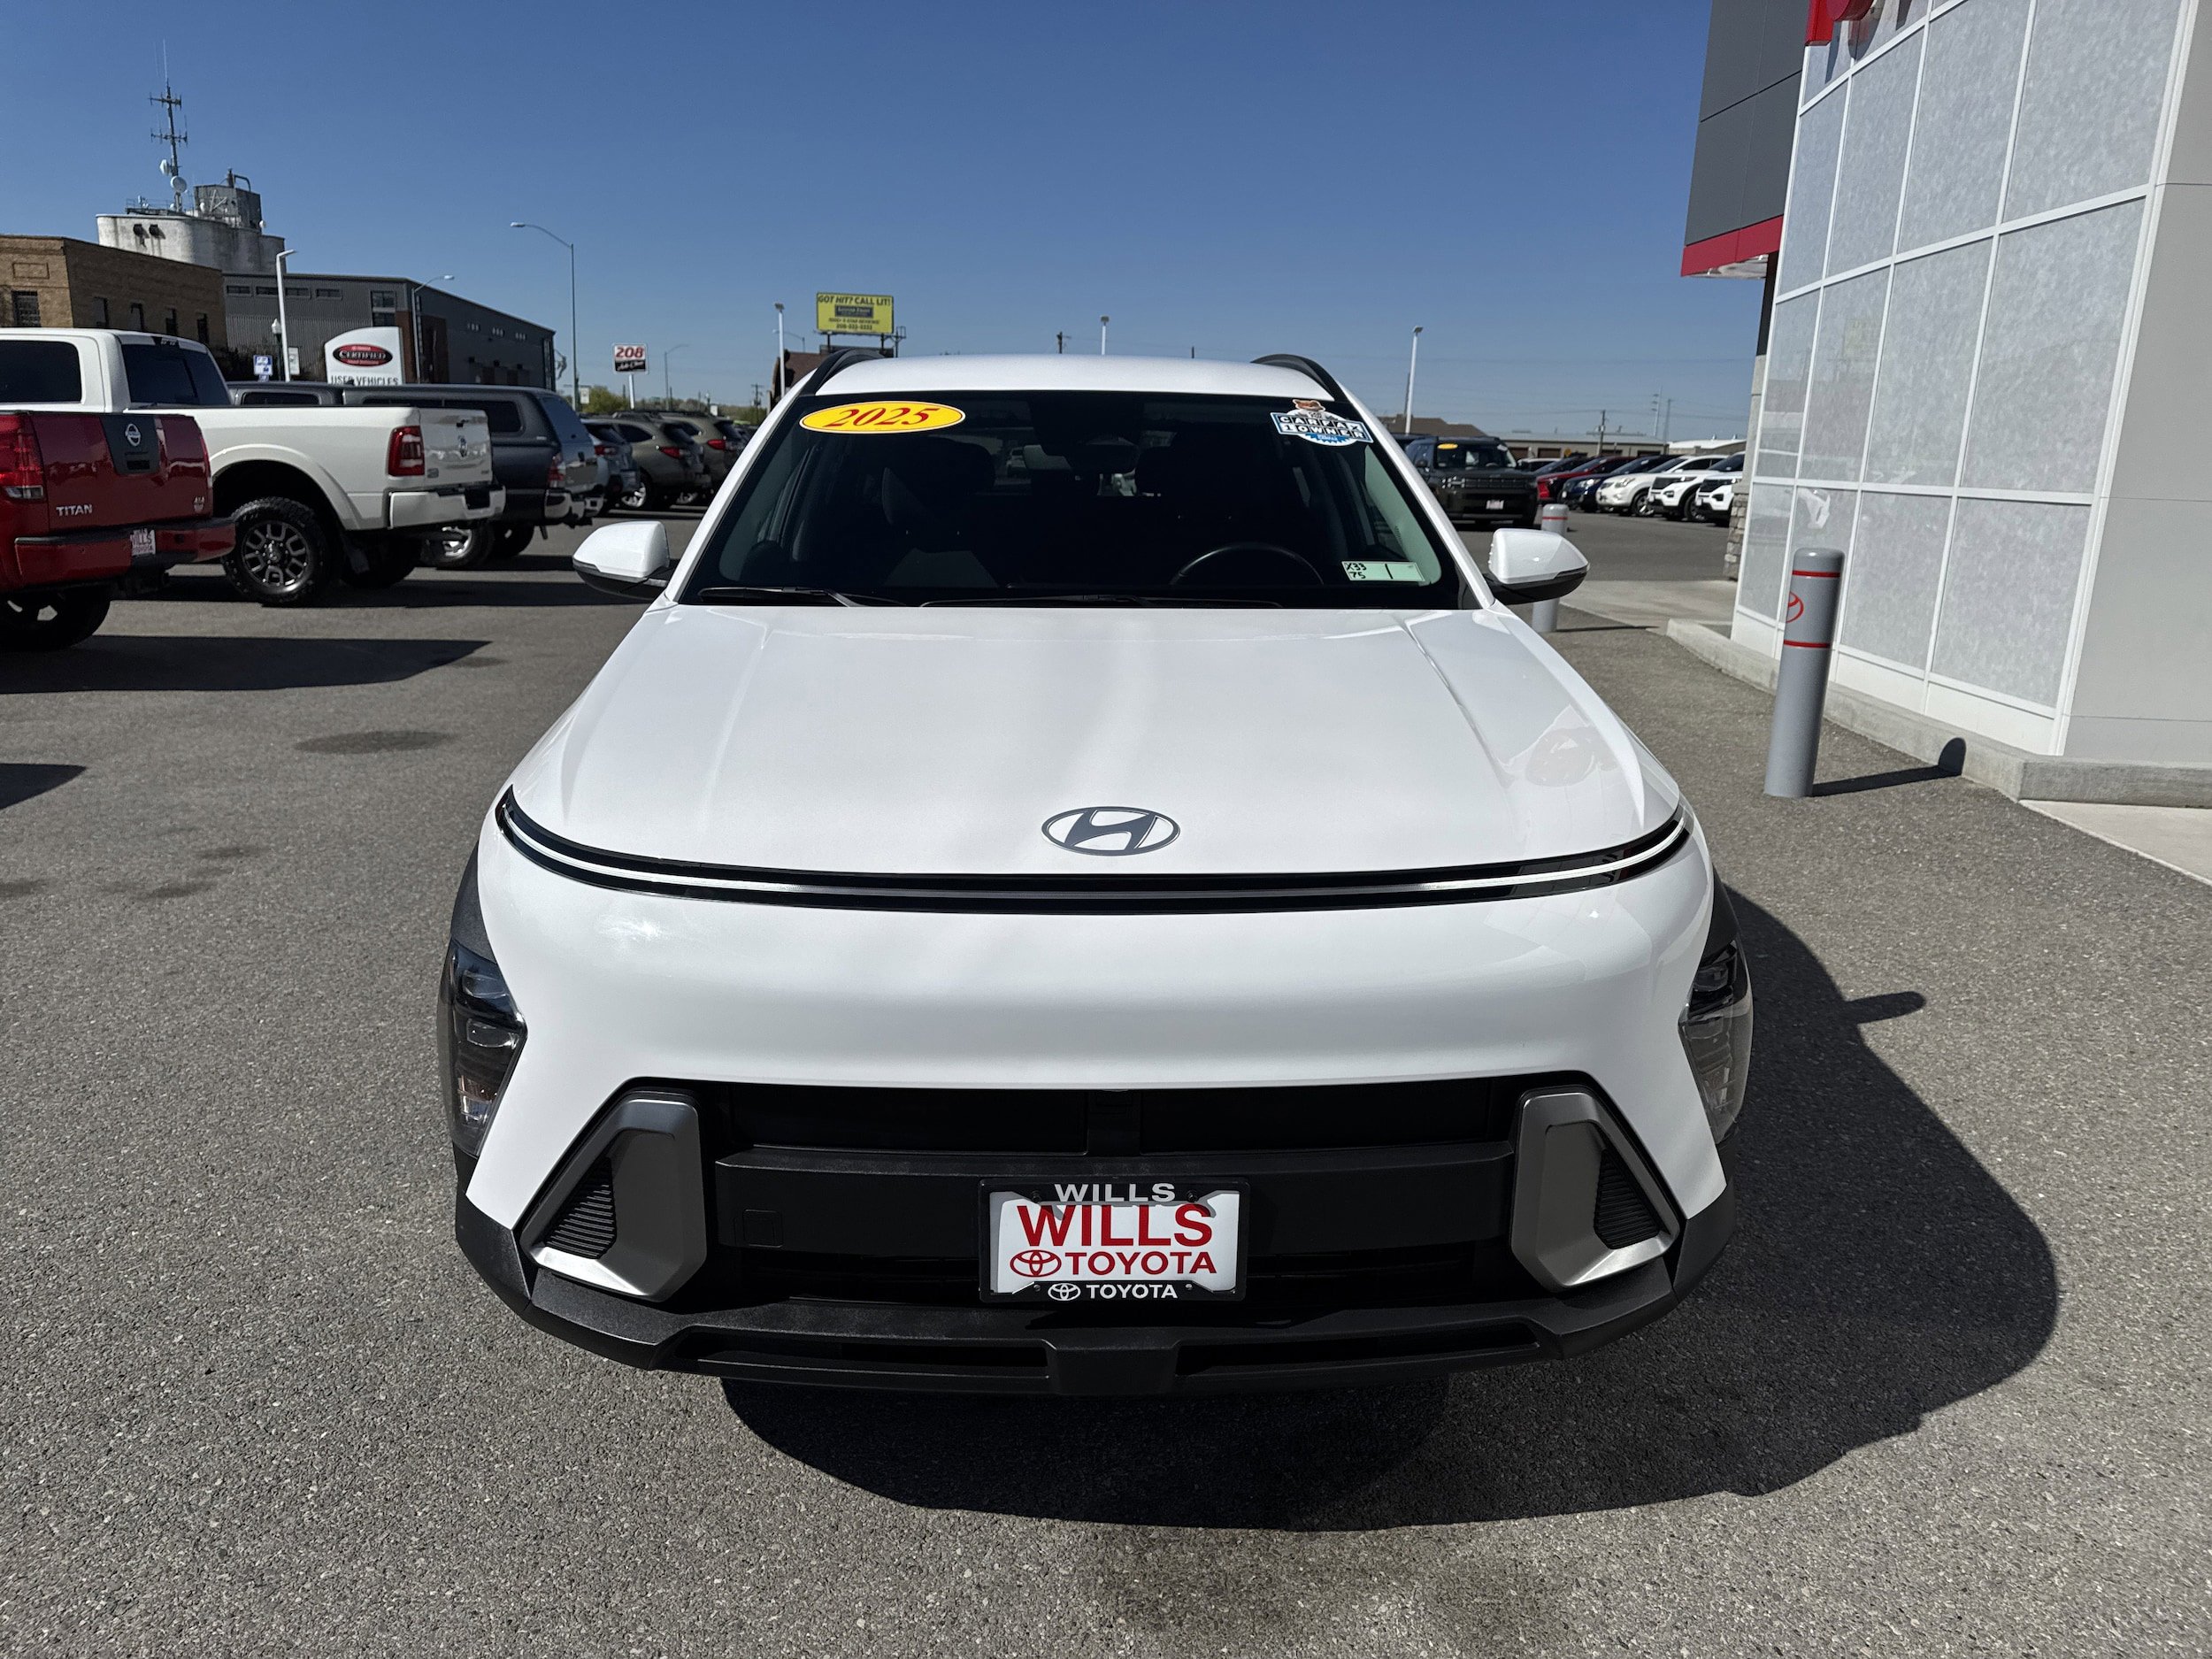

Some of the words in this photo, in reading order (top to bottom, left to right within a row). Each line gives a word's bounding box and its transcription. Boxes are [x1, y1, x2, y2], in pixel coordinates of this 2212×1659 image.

[835, 296, 853, 304] HIT?
[855, 296, 875, 305] CALL
[616, 347, 644, 358] 208
[356, 376, 398, 387] VEHICLES
[822, 407, 941, 427] 2025
[1279, 416, 1362, 432] CARFAX
[1298, 426, 1363, 439] OWNER
[56, 503, 93, 517] TITAN
[1054, 1182, 1176, 1202] WILLS
[1017, 1203, 1213, 1248] WILLS
[1064, 1251, 1217, 1276] TOYOTA
[1086, 1284, 1179, 1300] TOYOTA
